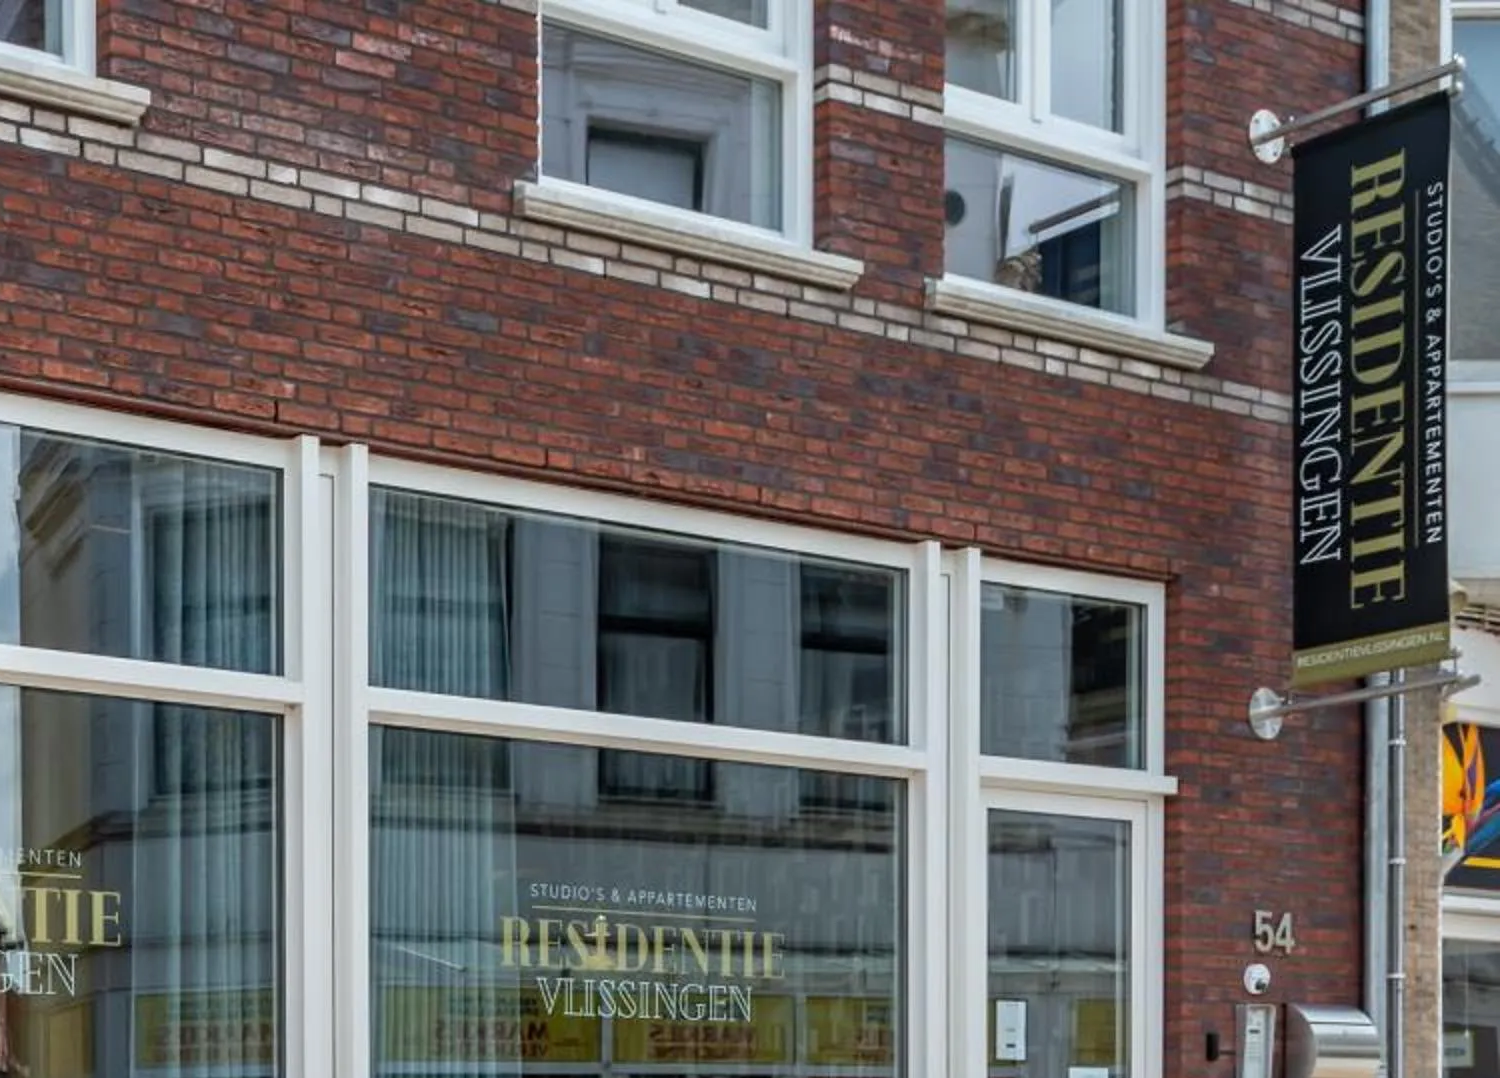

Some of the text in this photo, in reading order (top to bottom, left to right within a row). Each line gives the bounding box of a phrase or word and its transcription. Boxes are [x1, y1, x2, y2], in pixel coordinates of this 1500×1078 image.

[1299, 223, 1342, 565] VLISSINGEN
[1350, 148, 1406, 609] RESIDENTIE
[1424, 181, 1444, 544] STUDIO'S & APPARTEMENTEN
[530, 882, 758, 913] STUDIO'S & APPARTEMENTEN
[500, 915, 786, 980] RESIDENTIE
[1253, 909, 1295, 955] 54
[536, 976, 753, 1023] VLISSINGEN
